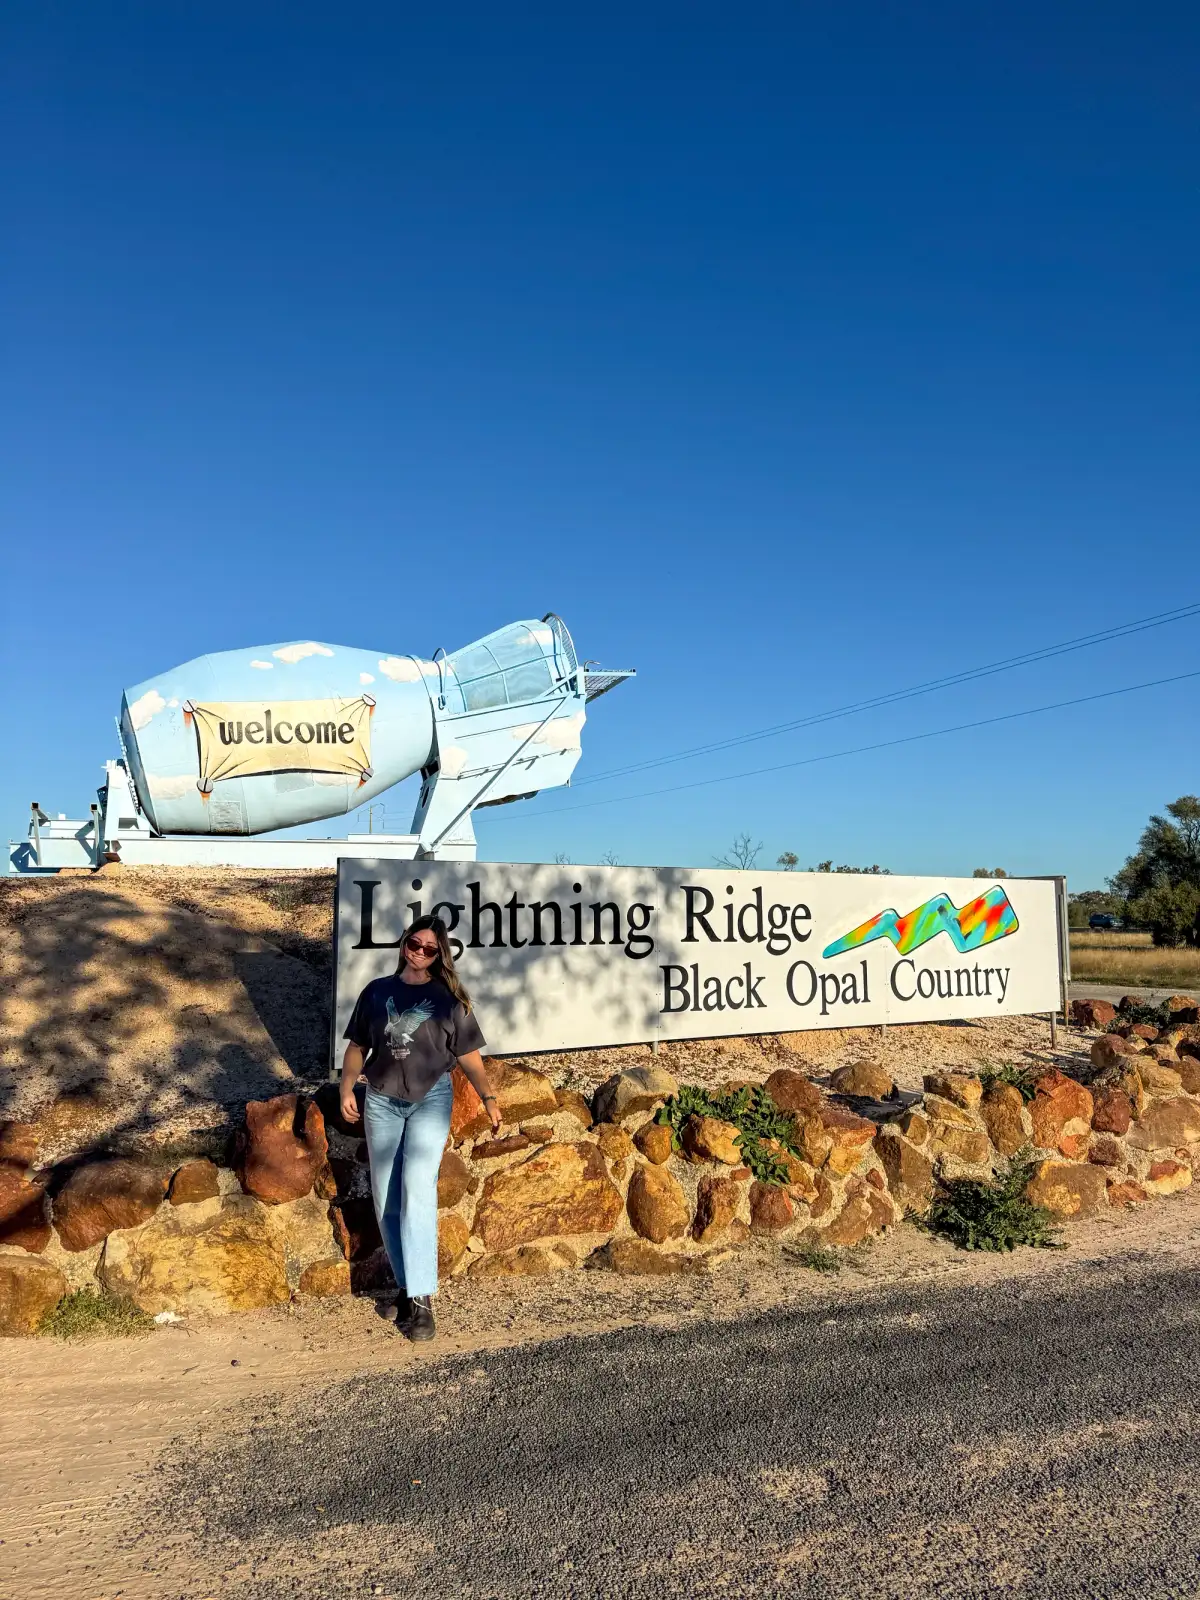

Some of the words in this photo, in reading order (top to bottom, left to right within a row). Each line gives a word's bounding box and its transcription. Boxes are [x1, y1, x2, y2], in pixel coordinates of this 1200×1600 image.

[219, 709, 355, 745] welcome
[352, 878, 655, 961] Lightning
[680, 884, 812, 956] Ridge
[659, 961, 767, 1013] Black
[785, 959, 871, 1015] Opal
[890, 958, 1011, 1004] Country
